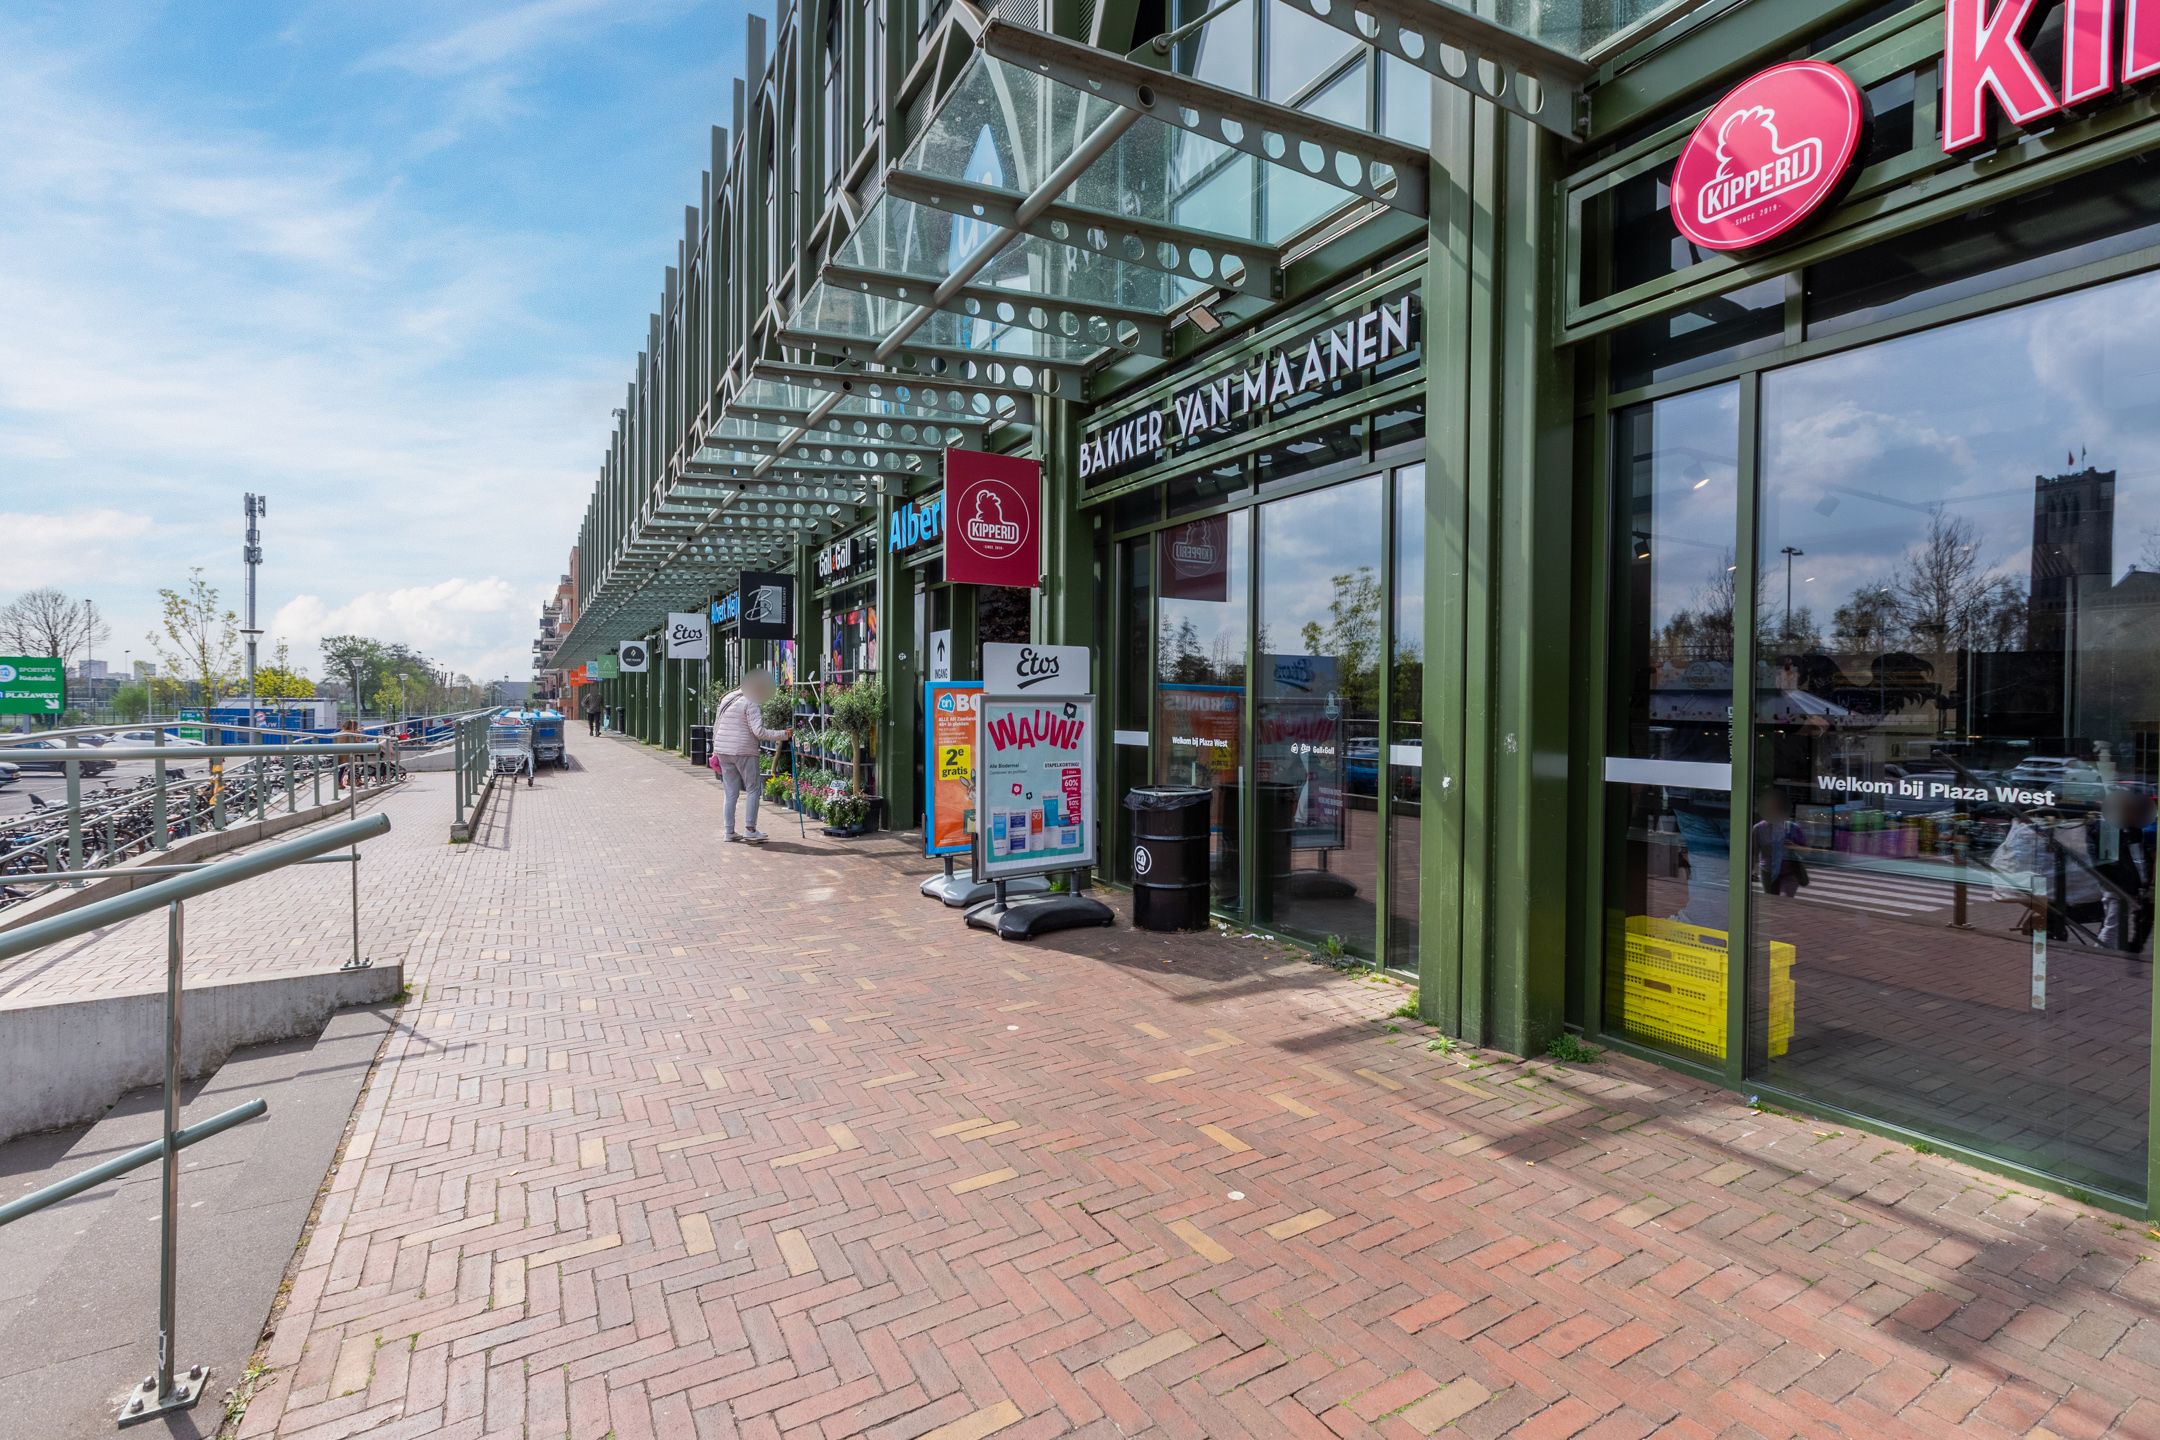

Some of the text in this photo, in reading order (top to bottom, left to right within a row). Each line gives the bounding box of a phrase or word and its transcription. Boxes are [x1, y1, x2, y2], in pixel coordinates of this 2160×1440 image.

[1706, 147, 1811, 215] KIPPERIJ
[1735, 203, 1778, 226] SINCE 2019
[1079, 296, 1411, 479] BAKKER VAN MAANEN
[971, 521, 1016, 541] KIPPERIJ
[673, 623, 703, 641] Etos
[1016, 647, 1060, 677] Etos
[934, 668, 949, 680] INGANG
[987, 708, 1085, 752] WAUW!
[1172, 736, 1229, 749] Welkom bij Plaza West
[942, 766, 968, 778] gratis
[1064, 779, 1079, 787] 60%
[1817, 774, 2056, 807] Welkom bij Plaza West
